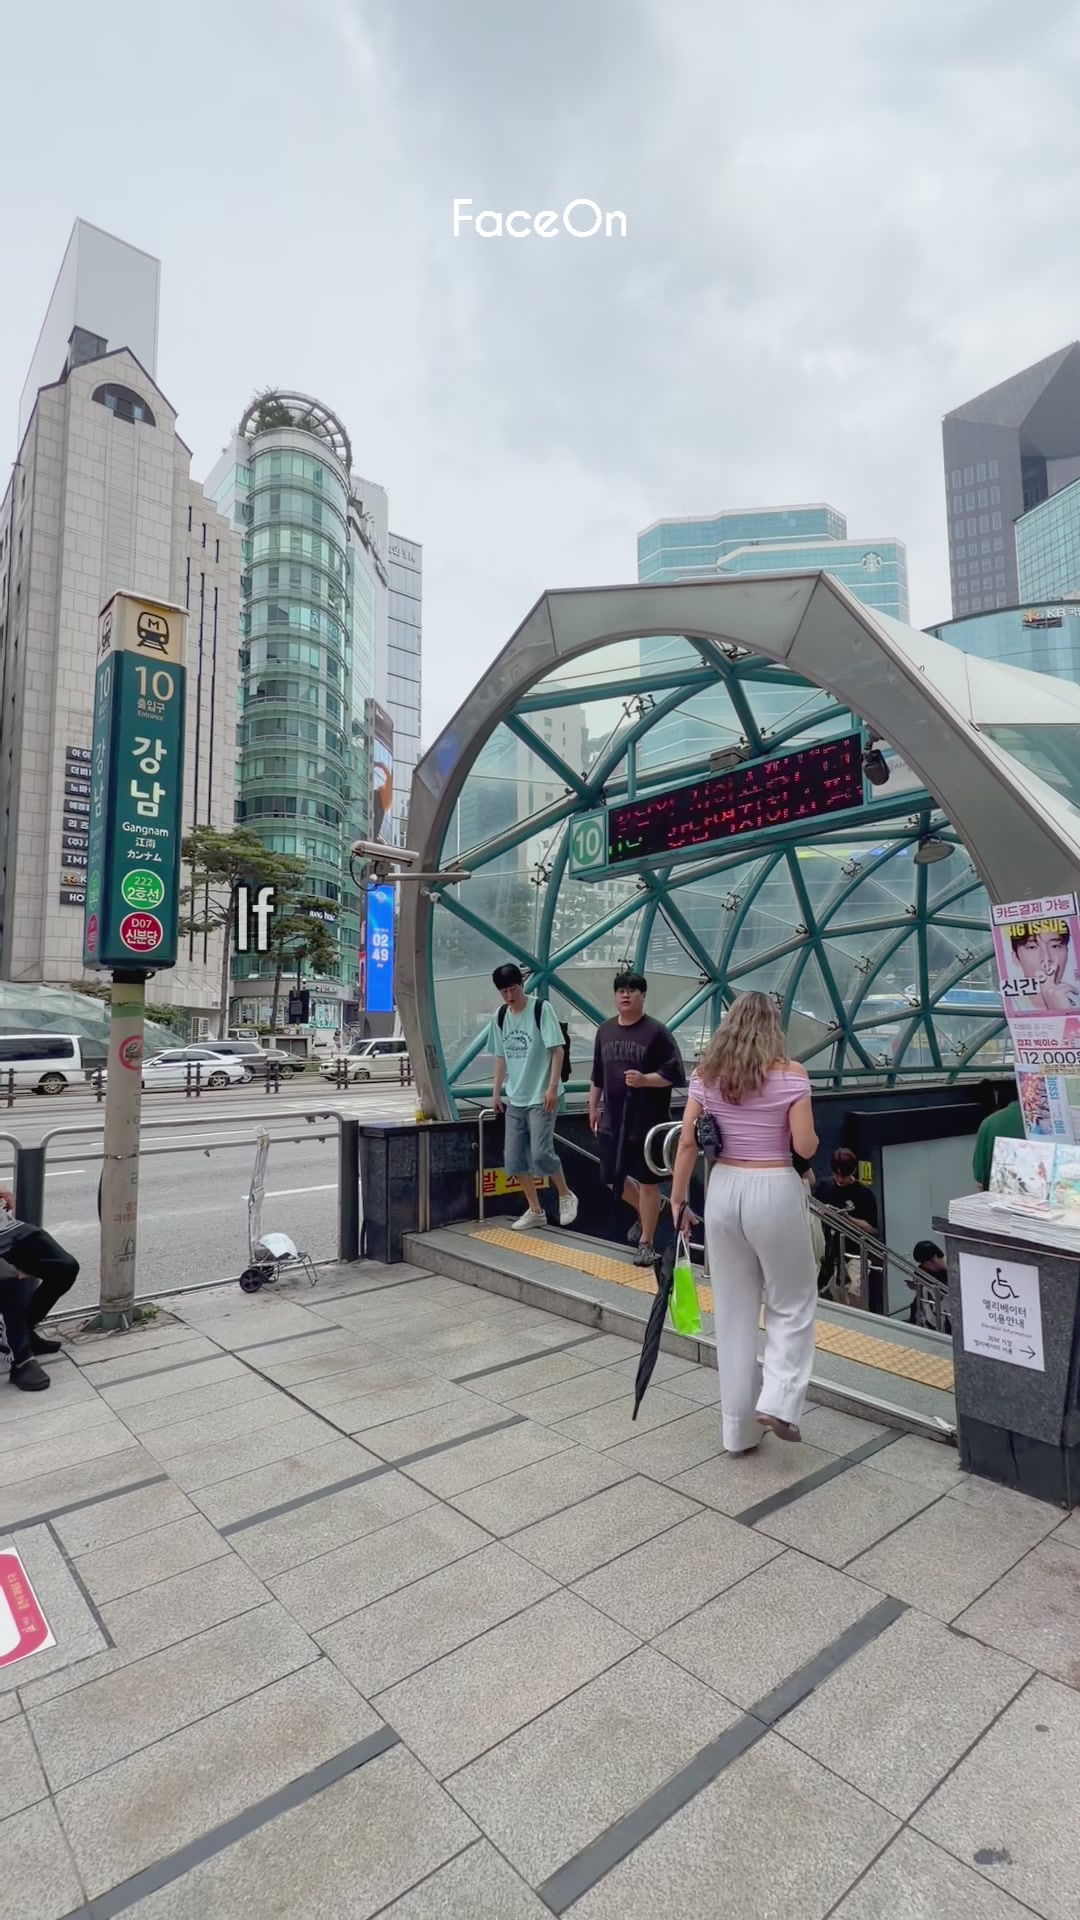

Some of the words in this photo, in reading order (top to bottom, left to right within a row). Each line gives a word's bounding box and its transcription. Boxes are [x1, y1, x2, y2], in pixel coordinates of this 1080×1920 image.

[99, 666, 111, 702] 10
[134, 666, 175, 701] 10
[137, 697, 166, 714] 출입구
[137, 710, 164, 722] Entrance
[131, 736, 168, 818] 강남
[122, 821, 169, 837] Gangnam
[135, 837, 156, 849] 江南
[575, 828, 600, 859] 10
[127, 849, 162, 862] カンナム
[134, 876, 153, 887] 222
[127, 887, 160, 904] 2호선
[996, 902, 1042, 919] 카드결제
[1045, 899, 1070, 911] 가능
[131, 918, 152, 928] D07
[1028, 918, 1068, 936] ISSUE
[125, 928, 159, 946] 신분당
[372, 933, 389, 947] 02
[372, 947, 389, 962] 49
[1002, 978, 1038, 997] 신간
[1034, 1039, 1059, 1047] 빅이슈
[982, 1299, 1027, 1318] 엘리베이터
[988, 1312, 1025, 1329] 이용안내
